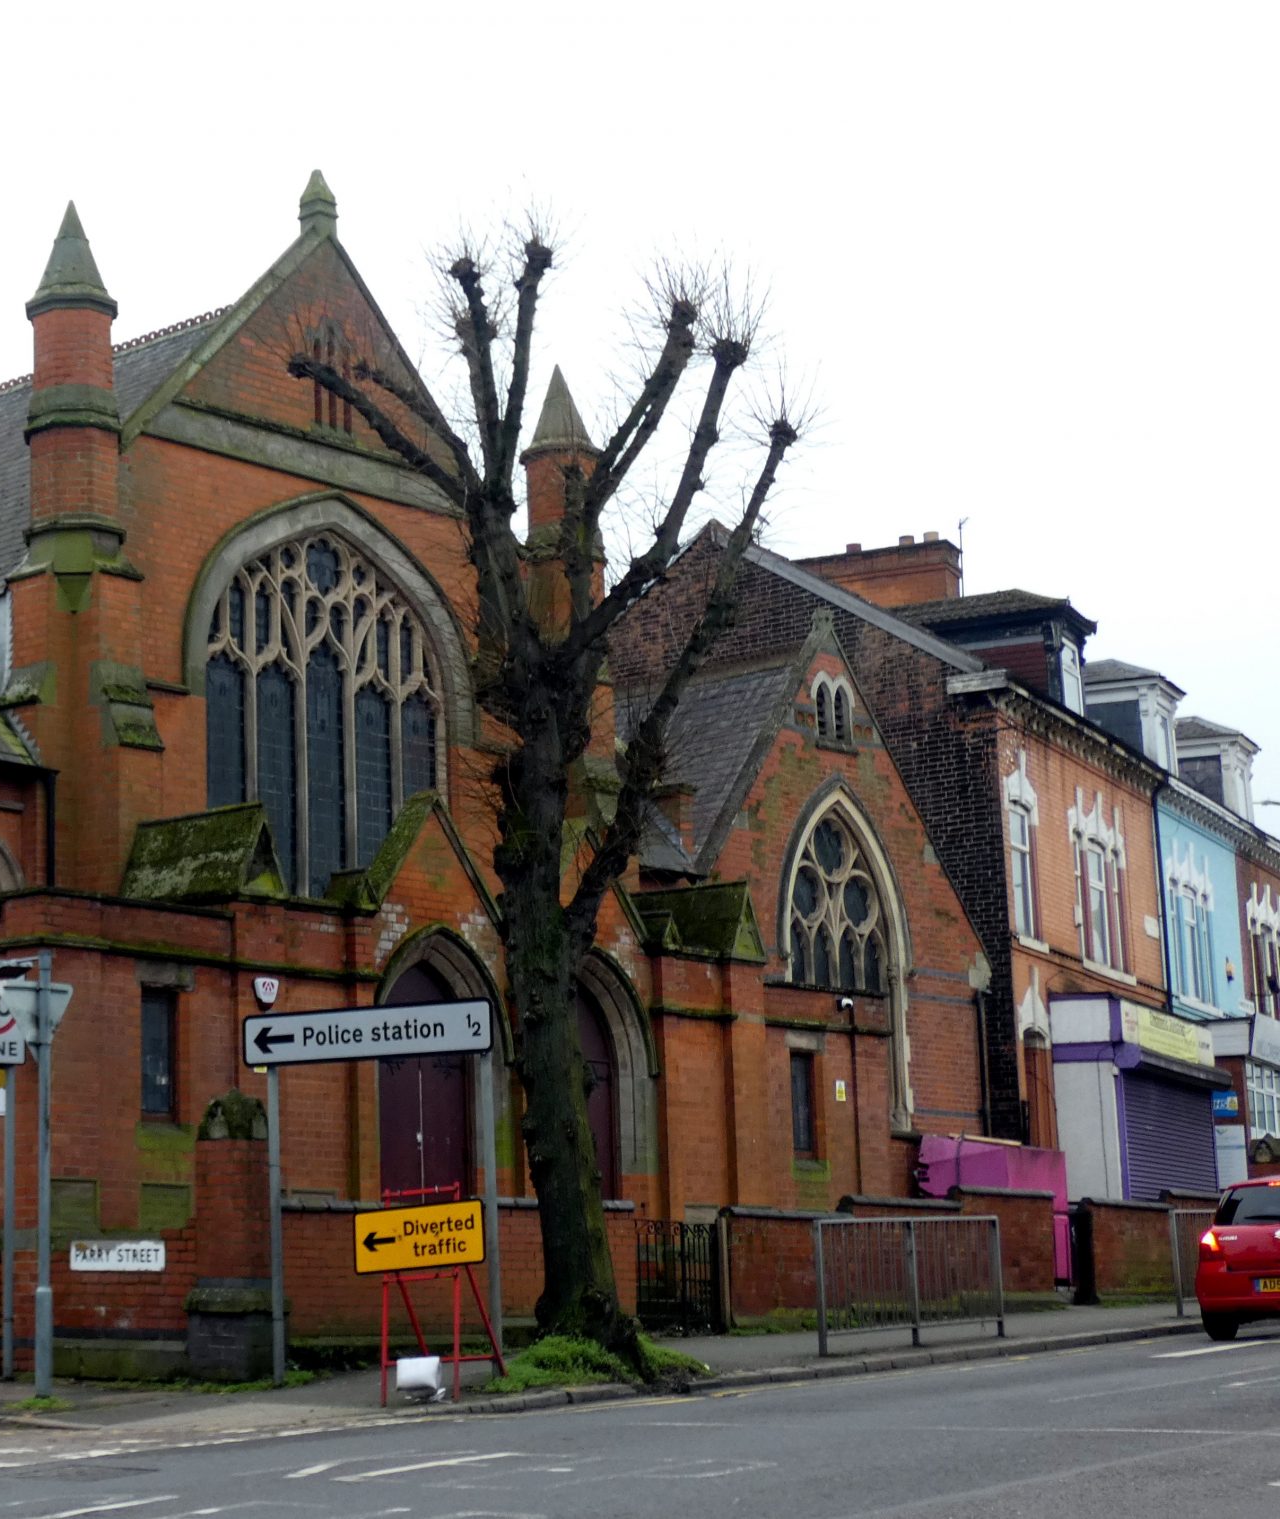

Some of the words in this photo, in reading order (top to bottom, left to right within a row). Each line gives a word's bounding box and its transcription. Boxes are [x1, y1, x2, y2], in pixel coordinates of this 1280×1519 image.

[302, 1024, 363, 1047] Police
[371, 1018, 445, 1043] station
[403, 1213, 475, 1237] Diverted
[74, 1248, 112, 1262] PARRY
[117, 1248, 160, 1263] STREET
[413, 1237, 467, 1257] traffic
